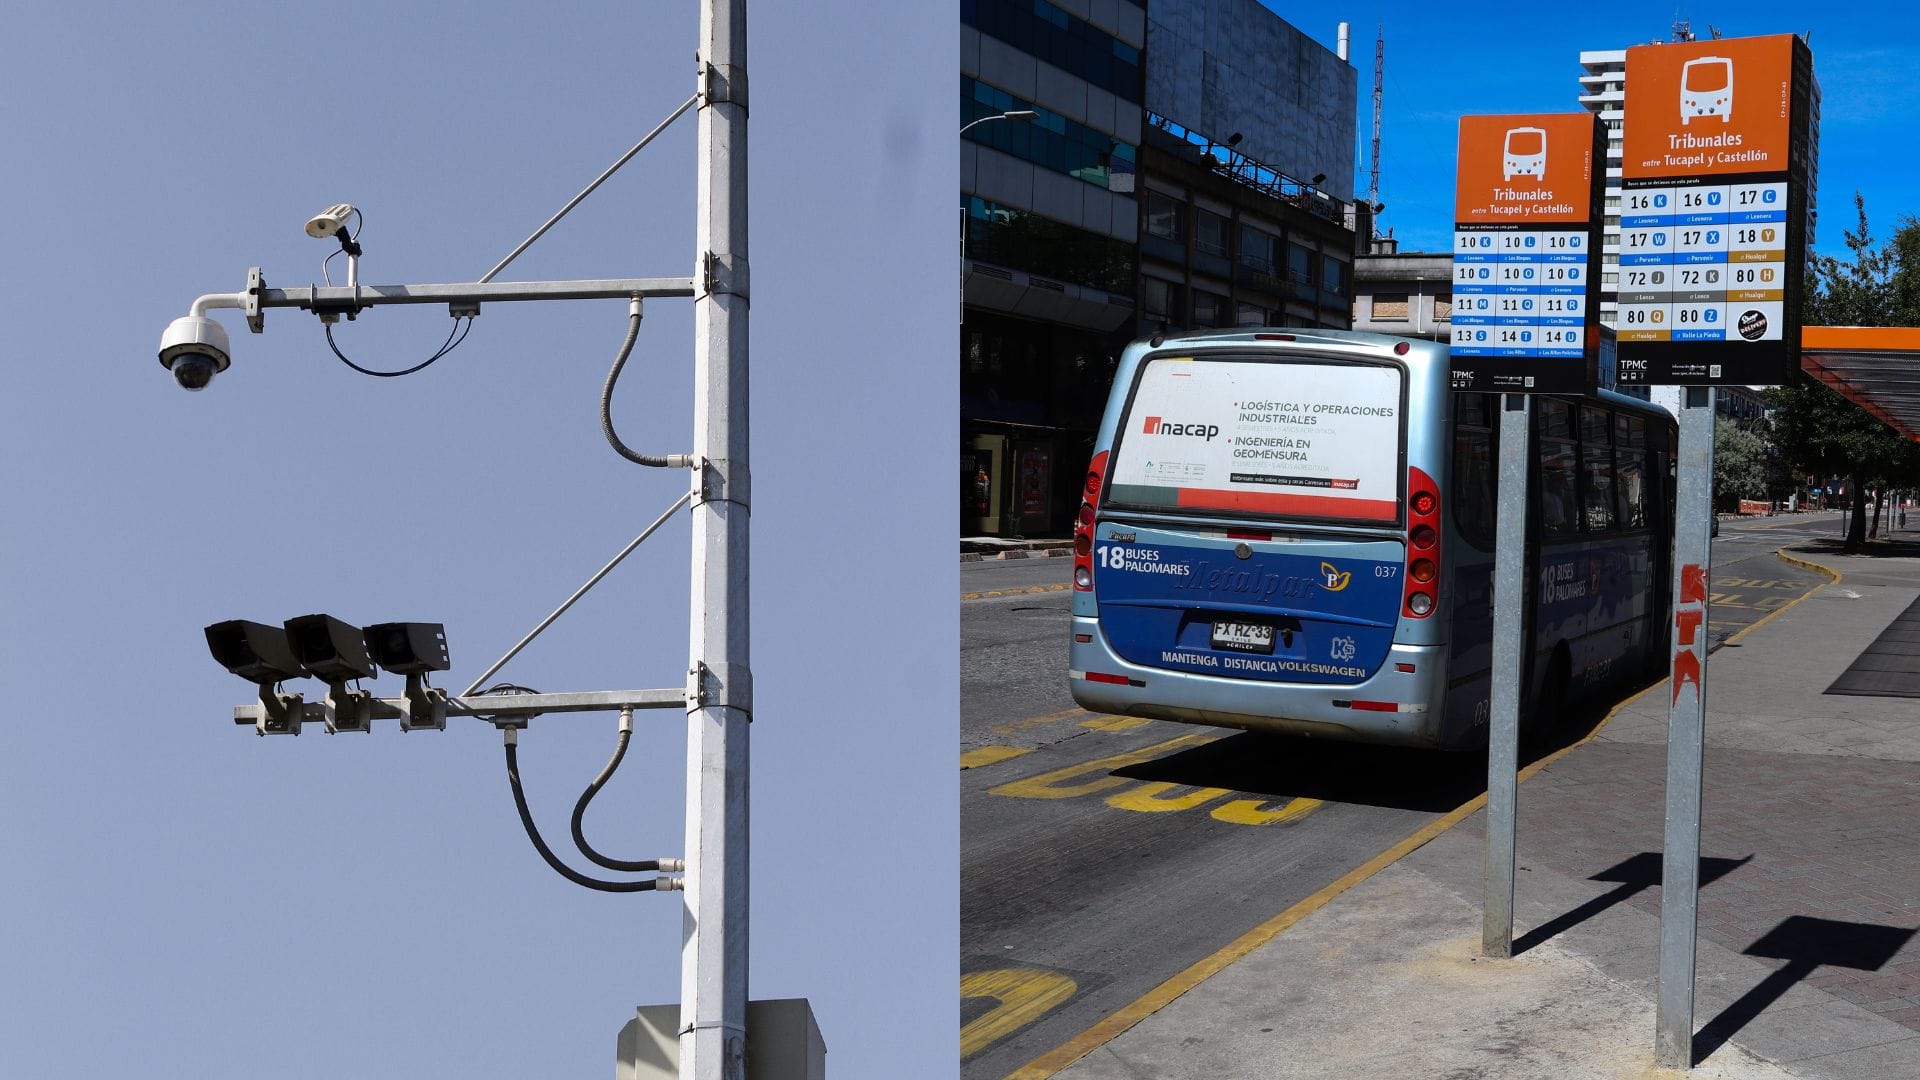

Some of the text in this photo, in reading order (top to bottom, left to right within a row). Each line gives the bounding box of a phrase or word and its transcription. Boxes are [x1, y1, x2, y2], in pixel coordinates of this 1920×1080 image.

[1668, 132, 1742, 150] Tribunales
[1642, 151, 1768, 168] entre Tucapel y Castellón
[1494, 188, 1552, 200] Tribunales
[1684, 194, 1720, 206] 16 V
[1740, 191, 1774, 204] 17 C
[1631, 196, 1666, 208] 16 K
[1490, 204, 1522, 214] Tucapel
[1526, 206, 1530, 216] y
[1533, 204, 1573, 214] Castellón
[1461, 237, 1489, 248] 10 K
[1506, 237, 1534, 248] 10 L
[1550, 237, 1579, 248] 10 M
[1630, 234, 1664, 246] 17 W
[1683, 232, 1718, 244] 17 X
[1738, 230, 1774, 243] 18 Y
[1460, 268, 1488, 278] 10 N
[1504, 268, 1520, 279] 10
[1549, 269, 1578, 279] 10 P
[1629, 272, 1663, 285] 72 J
[1682, 271, 1718, 284] 72 K
[1736, 270, 1772, 283] 80 H
[1458, 300, 1487, 310] 11 M
[1503, 300, 1532, 310] 11 Q
[1548, 300, 1576, 310] 11 R
[1628, 311, 1662, 324] 80 Q
[1680, 310, 1716, 322] 80 Z
[1458, 330, 1485, 341] 13 S
[1502, 331, 1530, 342] 14 T
[1546, 332, 1575, 342] 14 U
[1620, 360, 1648, 370] TPMC
[1452, 370, 1474, 379] TPMC
[1241, 400, 1394, 417] LOGÍSTICA Y OPERACIONES
[1238, 413, 1317, 424] INDUSTRIALES
[1143, 416, 1218, 442] inacap
[1235, 437, 1310, 448] INGENIERÍA EN
[1234, 449, 1307, 461] GEOMENSURA
[1097, 546, 1159, 569] 18 BUSES
[1126, 561, 1190, 576] PALOMARES
[1375, 566, 1396, 578] 037
[1541, 562, 1574, 604] 18 BUSES
[1556, 580, 1586, 601] PALOMARES
[1162, 652, 1366, 678] MANTENGA DISTANCIA VOLKSWAGEN
[1474, 700, 1490, 726] 03
